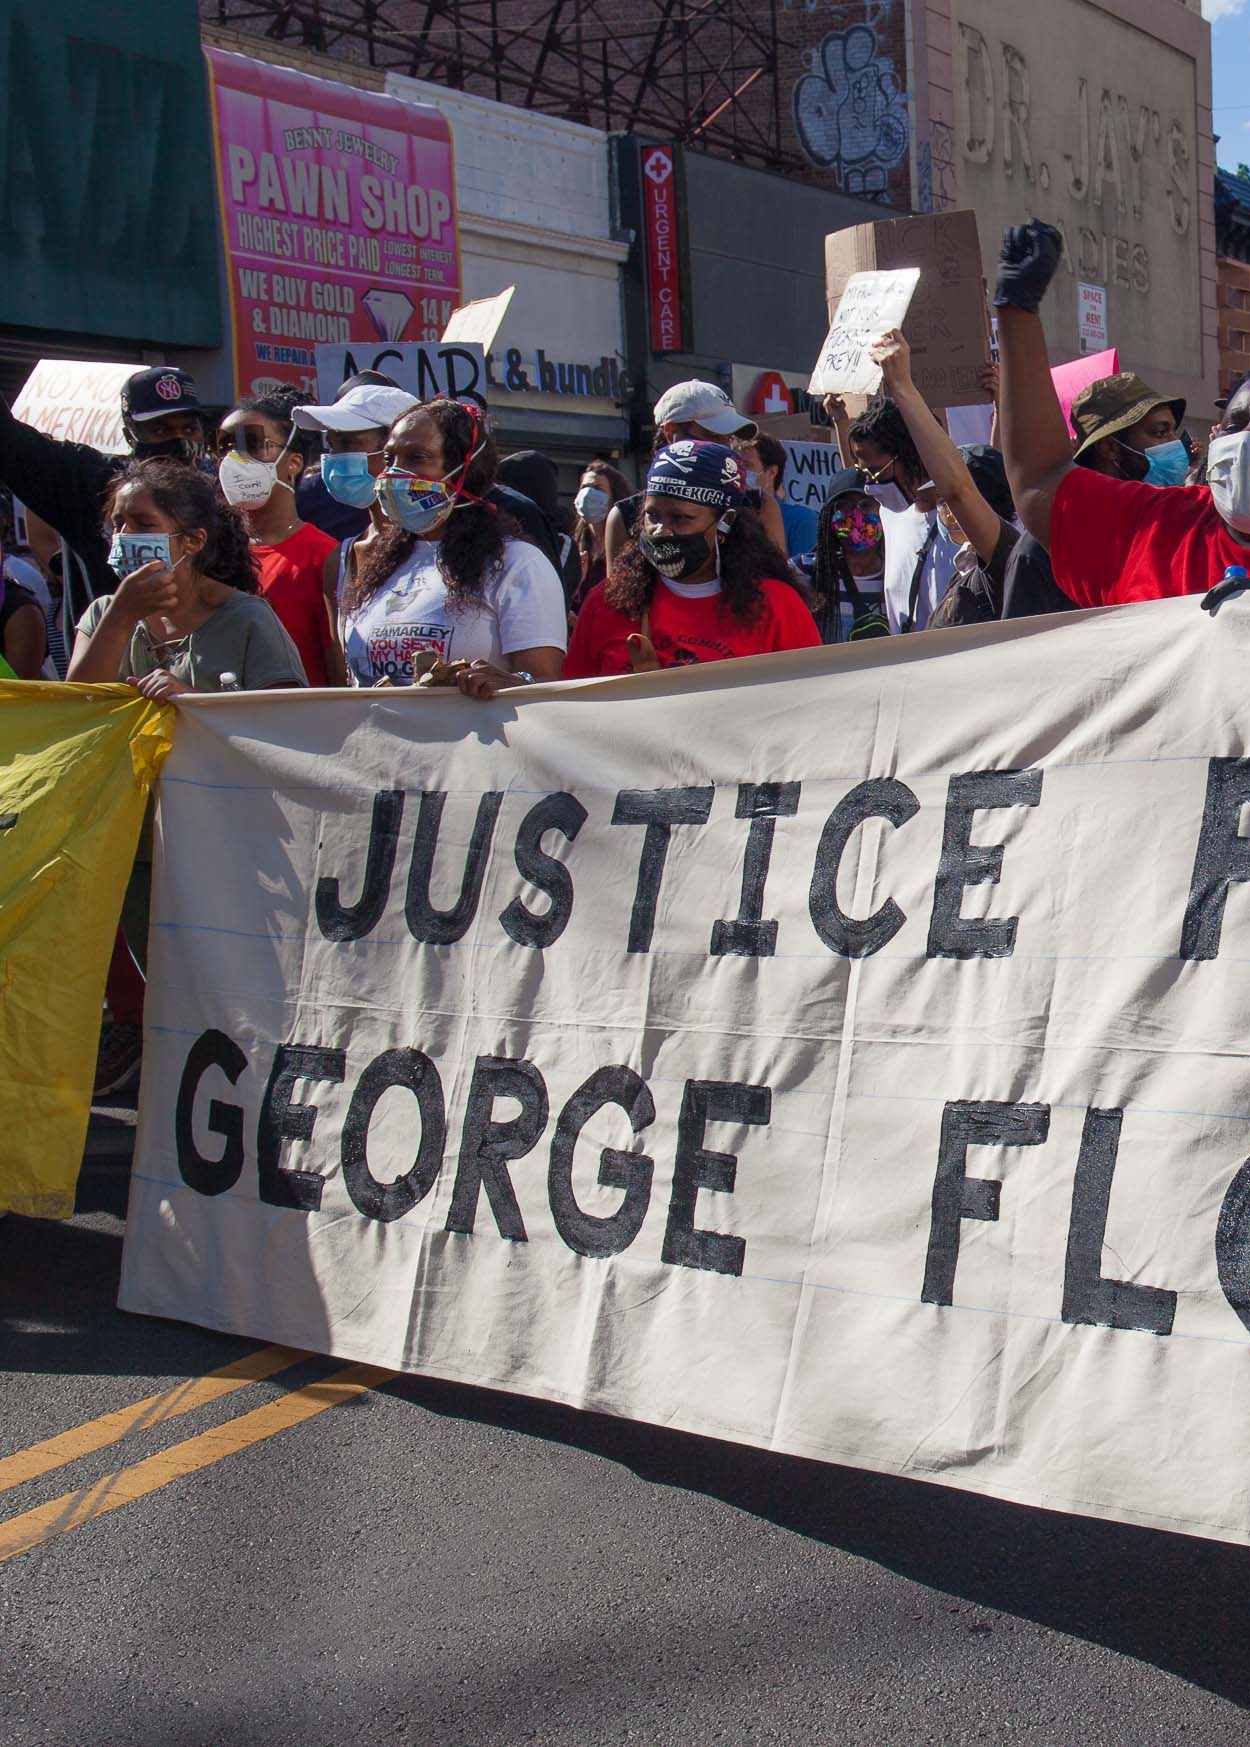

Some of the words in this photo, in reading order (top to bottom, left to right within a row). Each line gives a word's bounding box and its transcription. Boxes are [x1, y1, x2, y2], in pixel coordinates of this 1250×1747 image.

[283, 127, 332, 150] BENNY
[335, 130, 399, 175] JEWELRY
[957, 22, 1049, 190] DR.
[1064, 78, 1191, 236] JAY'S
[228, 144, 350, 225] PAWN
[360, 175, 451, 241] SHOP
[237, 212, 299, 258] HIGHEST
[303, 226, 345, 267] PRICE
[350, 236, 380, 273] PAID
[654, 188, 671, 281] URGENT
[239, 267, 268, 300] WE
[272, 274, 306, 307] BUY
[311, 281, 355, 314] GOLD
[420, 298, 438, 324] 14
[252, 307, 267, 333] &
[269, 307, 350, 343] DIAMOND
[659, 288, 673, 350] CARE
[69, 368, 121, 404] MO
[505, 348, 530, 392] &
[19, 405, 124, 449] AMERIKKK
[370, 639, 397, 650] YOU
[371, 625, 450, 639] RAMARLEY
[369, 650, 391, 661] MY
[373, 661, 398, 676] NO
[315, 768, 1043, 959] JUSTICE
[176, 1029, 771, 1276] GEORGE
